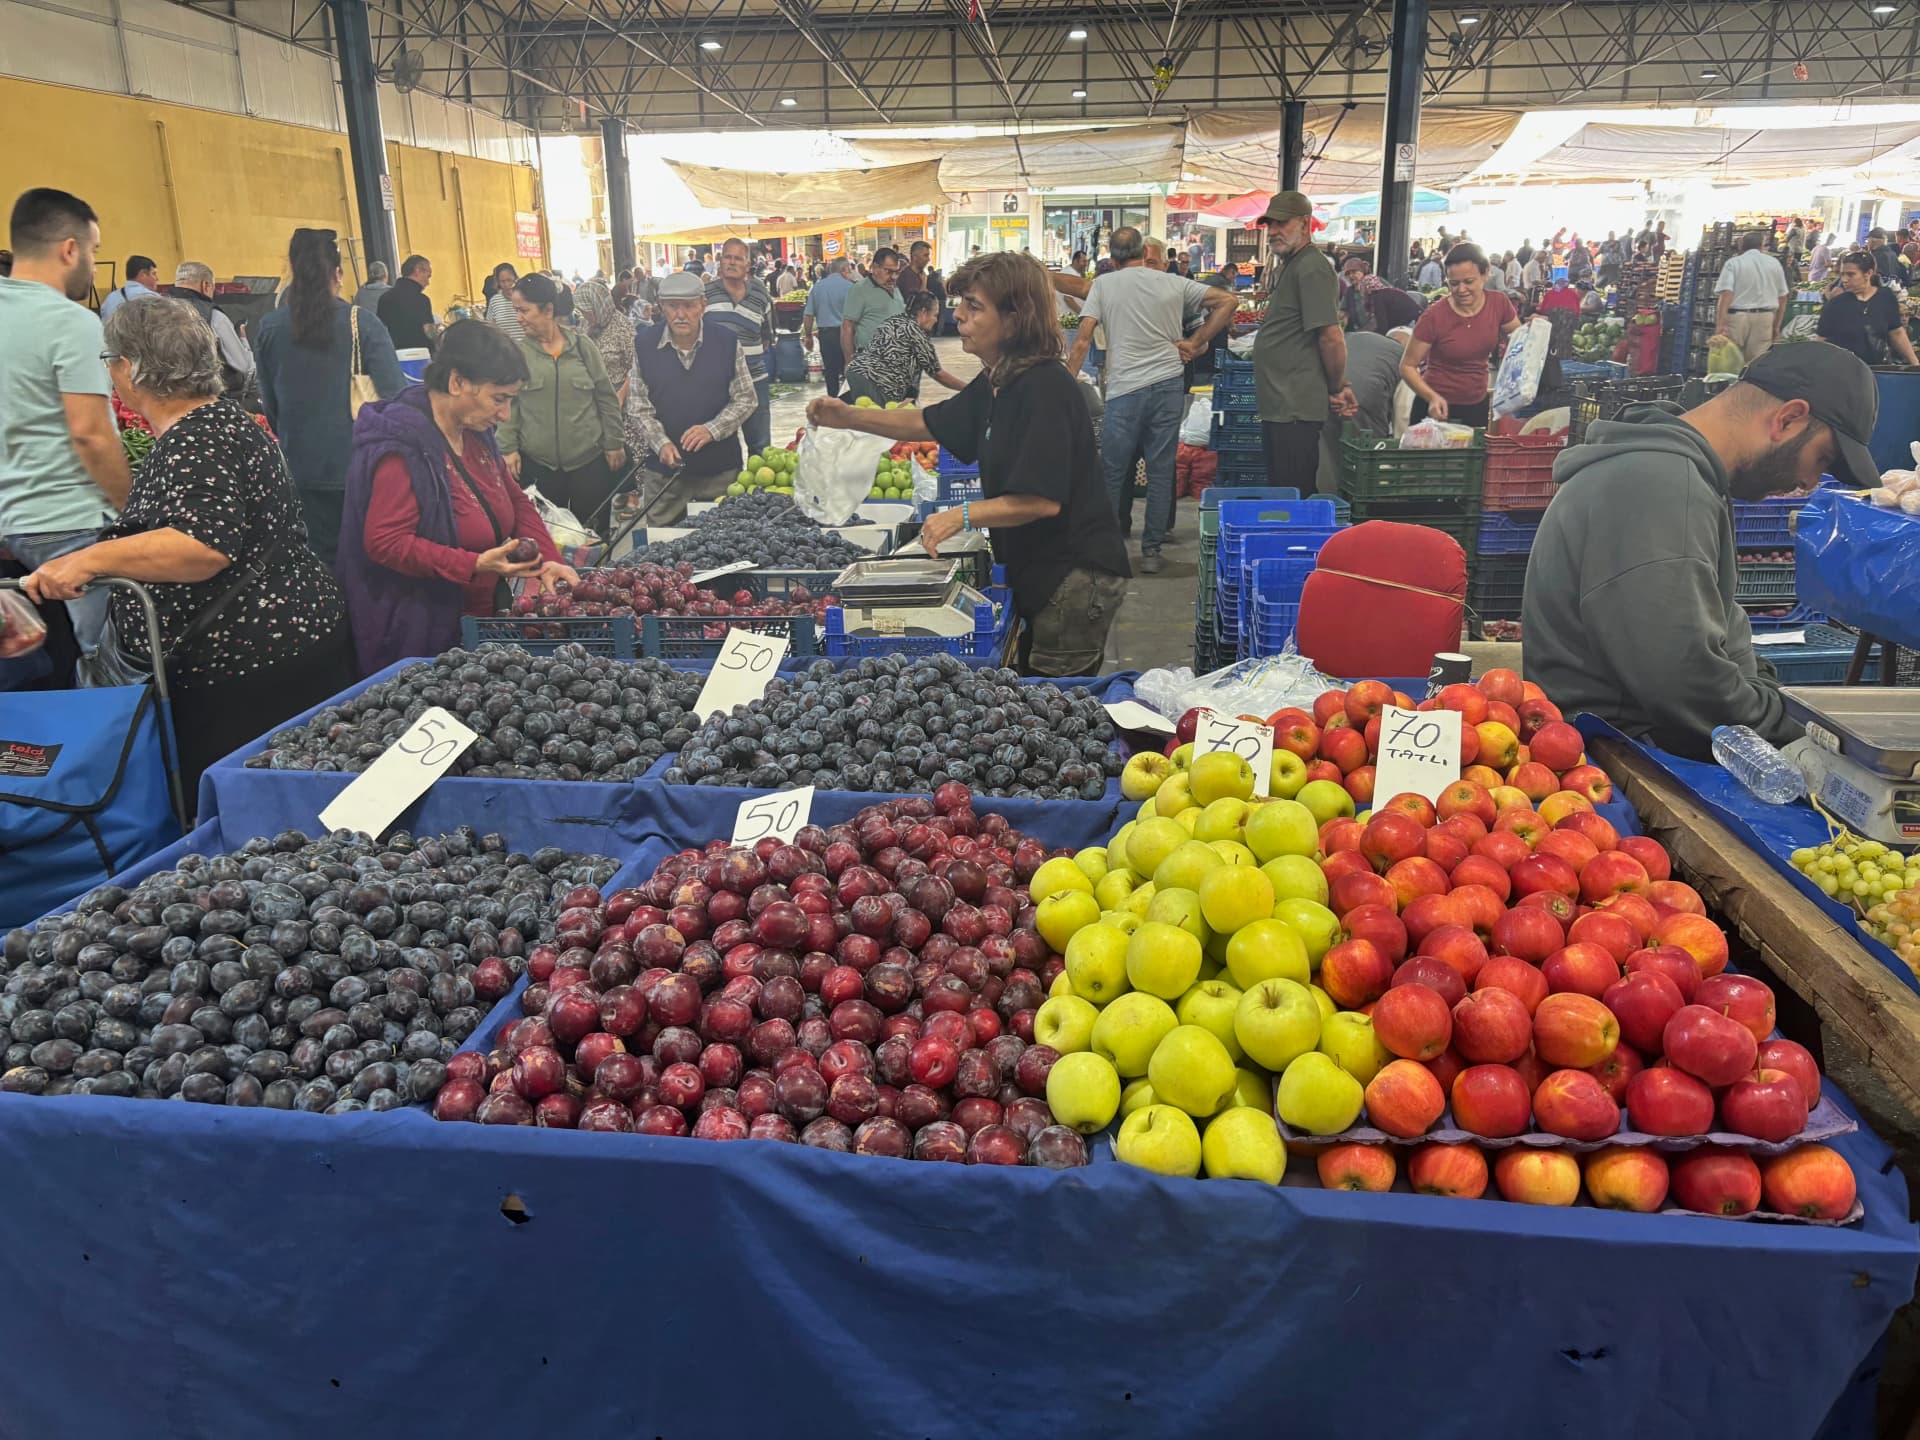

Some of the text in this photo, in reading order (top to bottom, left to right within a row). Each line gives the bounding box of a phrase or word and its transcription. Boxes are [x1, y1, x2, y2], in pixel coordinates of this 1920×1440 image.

[720, 641, 773, 672] 50
[398, 719, 459, 766] 50
[1208, 720, 1261, 761] 70
[1388, 709, 1440, 748] 70
[1385, 748, 1448, 766] TATLI
[735, 800, 799, 841] 50
